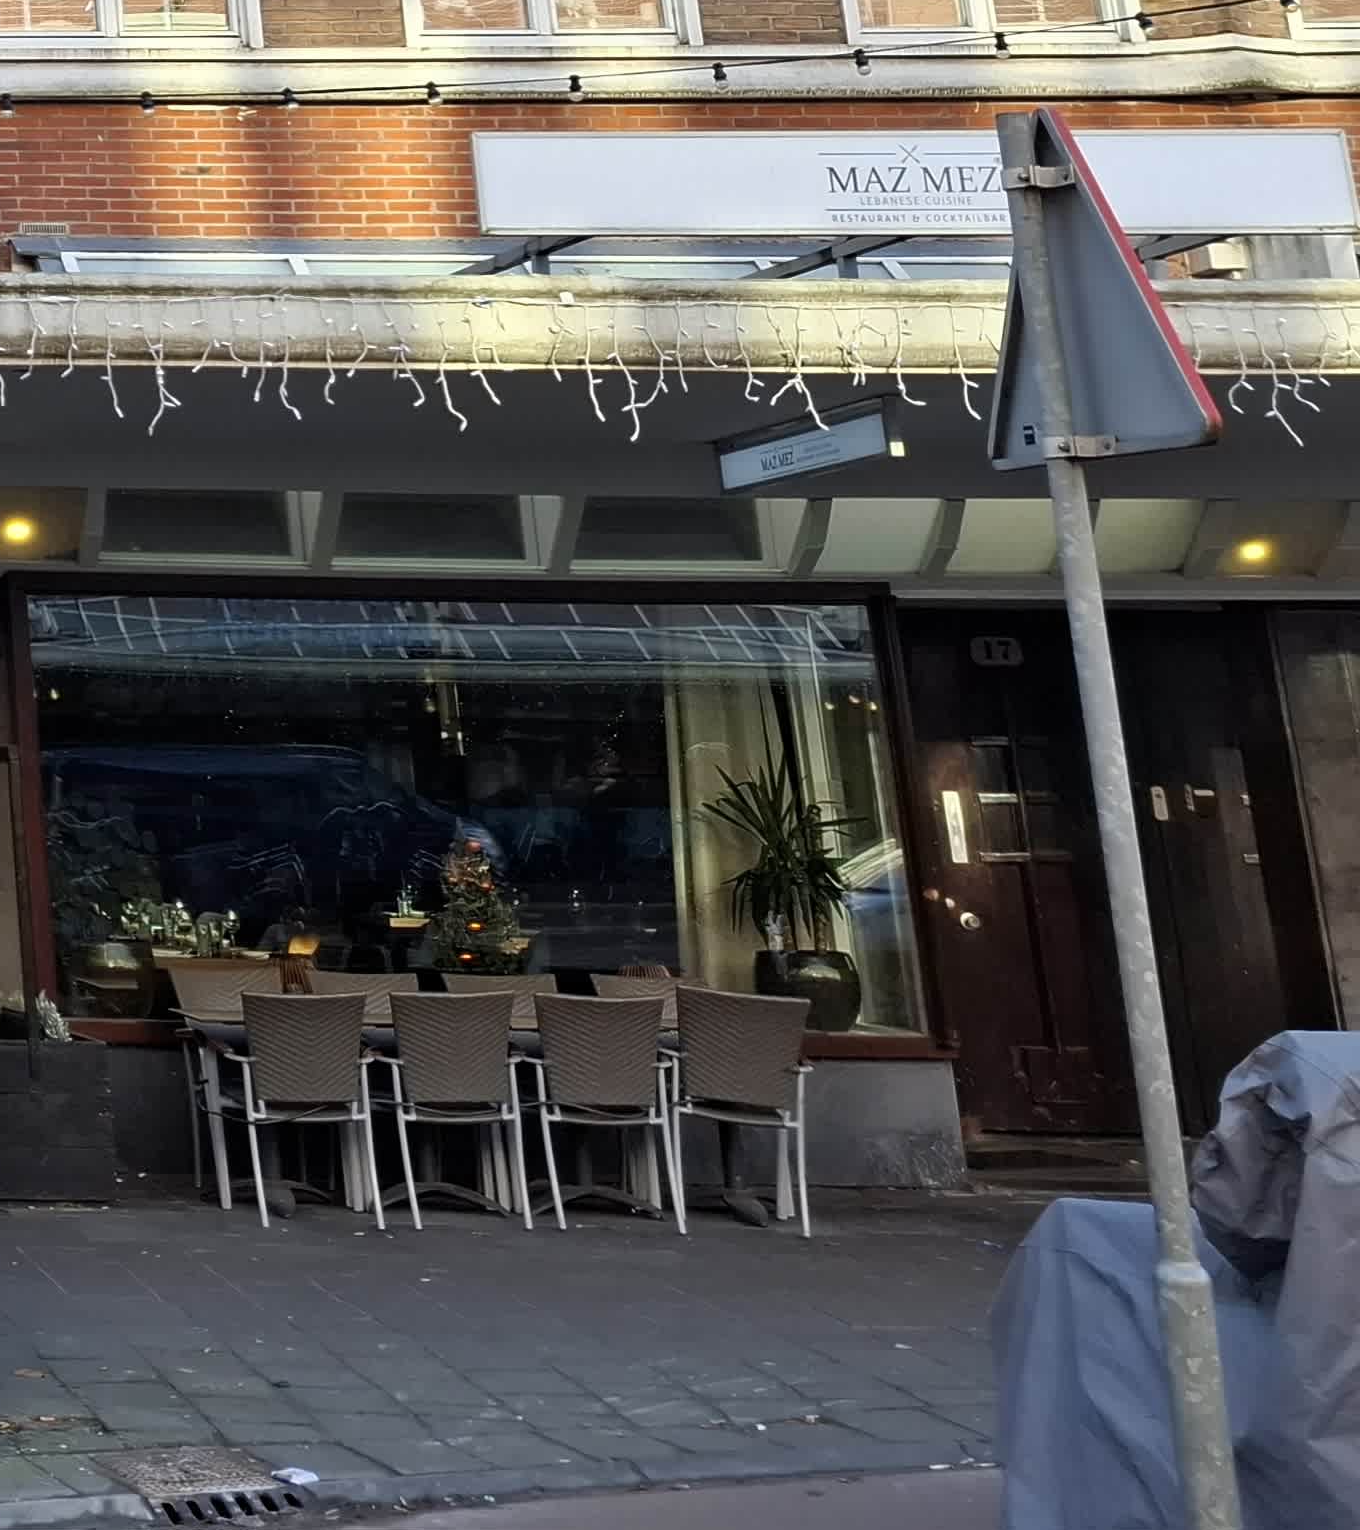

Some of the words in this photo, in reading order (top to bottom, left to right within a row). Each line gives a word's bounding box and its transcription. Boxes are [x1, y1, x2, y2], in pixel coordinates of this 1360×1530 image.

[826, 166, 911, 194] MAZ
[859, 196, 921, 206] LEBANESE
[925, 196, 973, 206] CUISINE
[832, 213, 907, 223] RESTAURANT
[912, 213, 921, 223] &
[926, 212, 1009, 223] COCKTAILBAR
[983, 639, 1012, 660] 17
